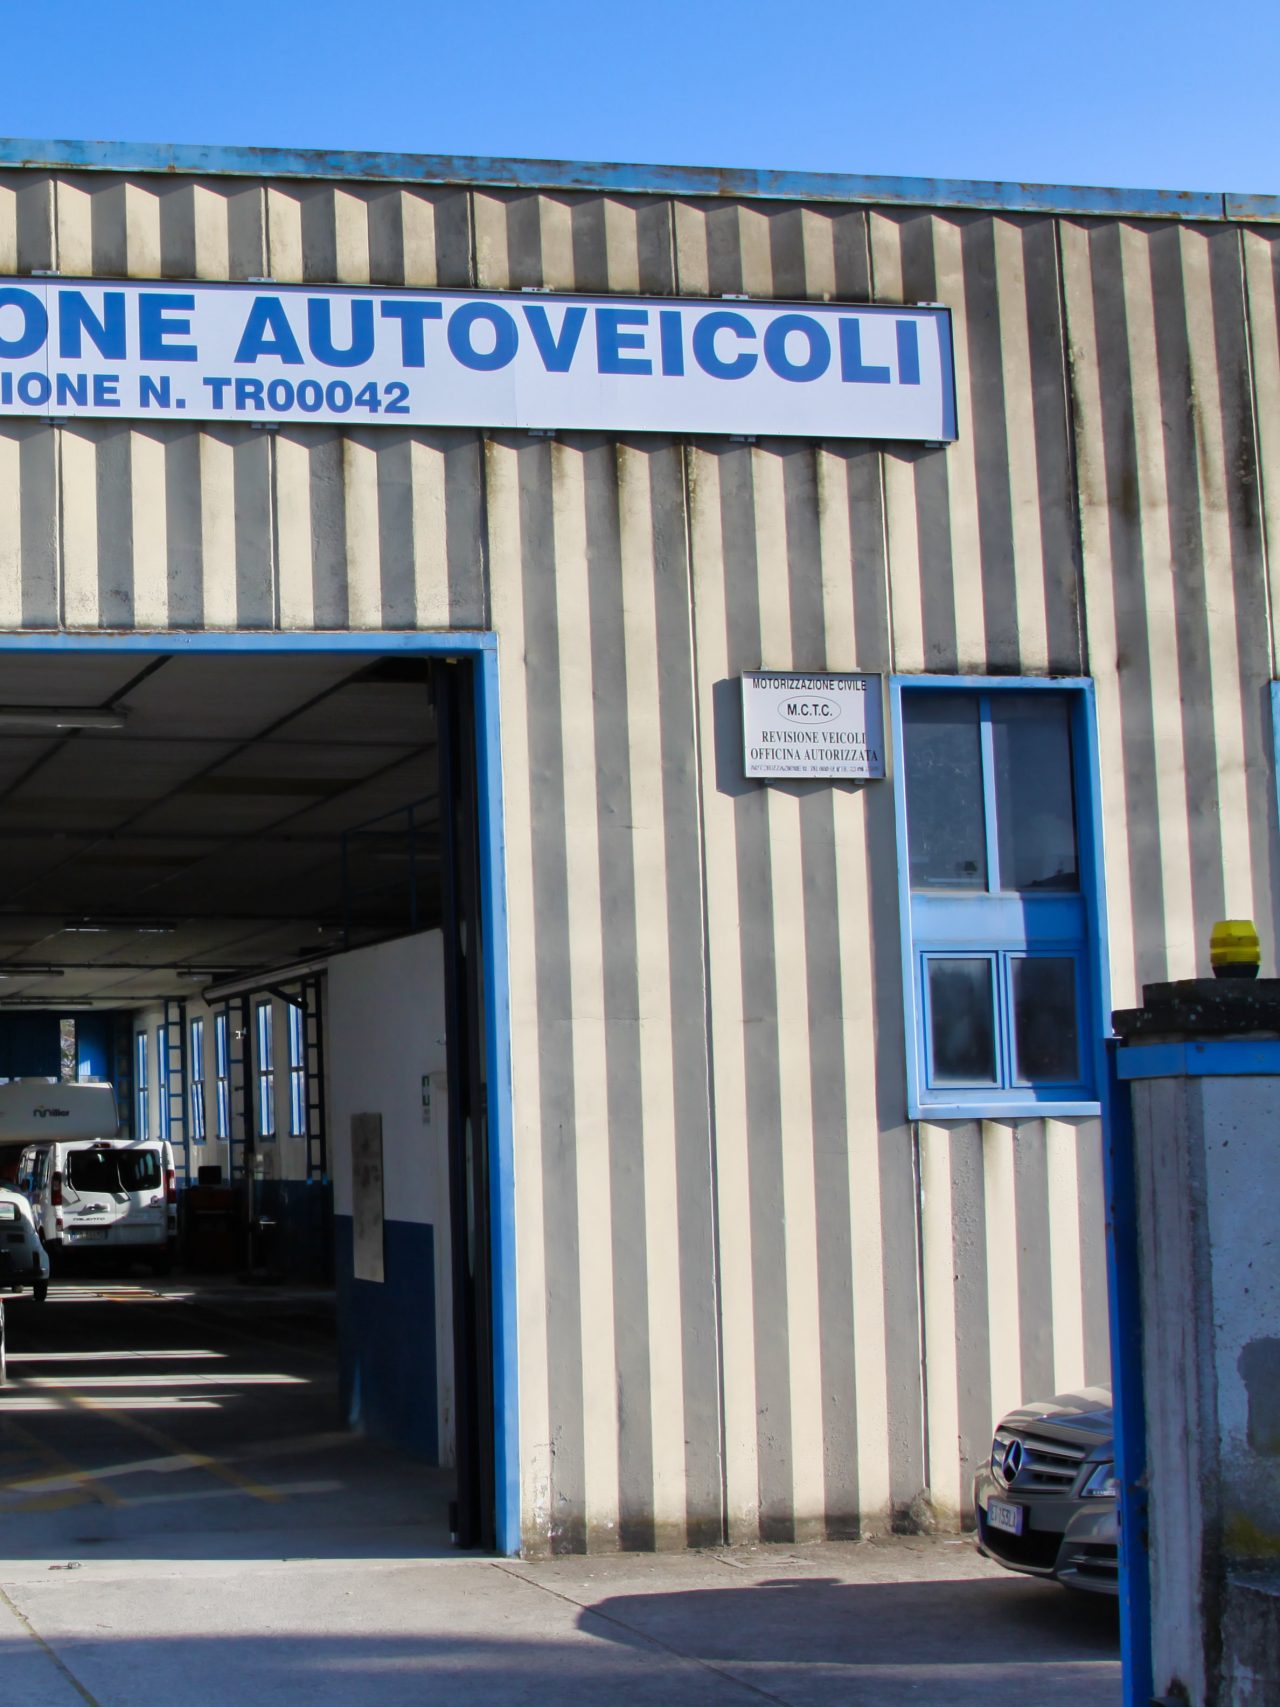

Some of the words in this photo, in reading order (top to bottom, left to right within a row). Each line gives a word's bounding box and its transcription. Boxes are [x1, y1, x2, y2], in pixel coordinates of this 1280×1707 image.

[234, 297, 921, 385] AUTOVEICOLI
[139, 375, 186, 409] N.
[203, 377, 411, 414] TR00042
[752, 678, 835, 691] MOTORIZZAZIONE
[838, 680, 867, 691] CIVILE
[787, 704, 833, 717] M.C.T.C.
[762, 731, 819, 743] REVISIONE
[821, 732, 866, 744] VEICOLI
[750, 748, 801, 760] OFFICINA
[804, 749, 878, 761] AUTORIZZATA
